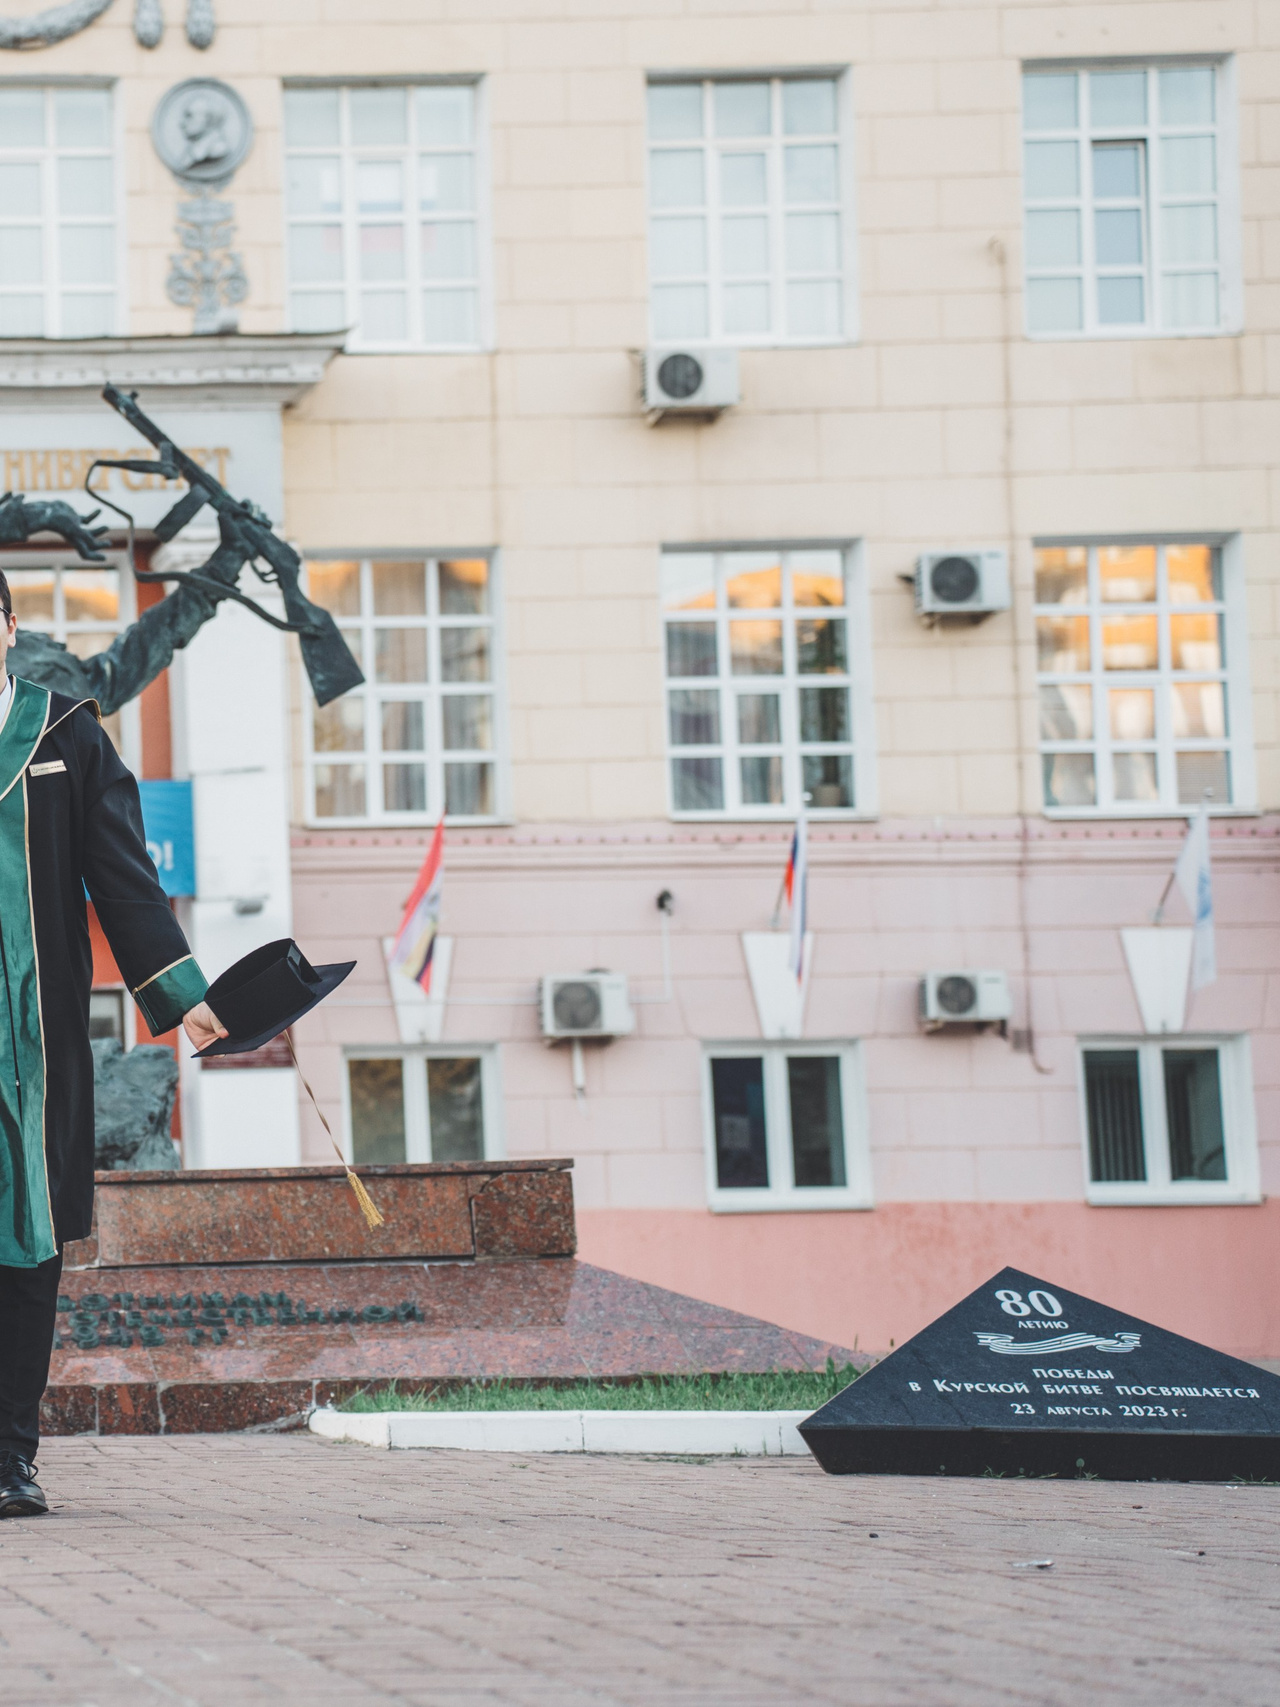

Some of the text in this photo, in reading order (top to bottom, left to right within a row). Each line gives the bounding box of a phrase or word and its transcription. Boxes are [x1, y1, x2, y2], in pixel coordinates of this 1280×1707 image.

[995, 1290, 1062, 1317] 80
[1018, 1320, 1069, 1330] ЛЕТИЮ
[1032, 1368, 1115, 1380] ПОБЕДЫ
[1042, 1384, 1104, 1395] БИТВЕ
[1010, 1403, 1036, 1415] 23
[1118, 1404, 1169, 1417] 2023
